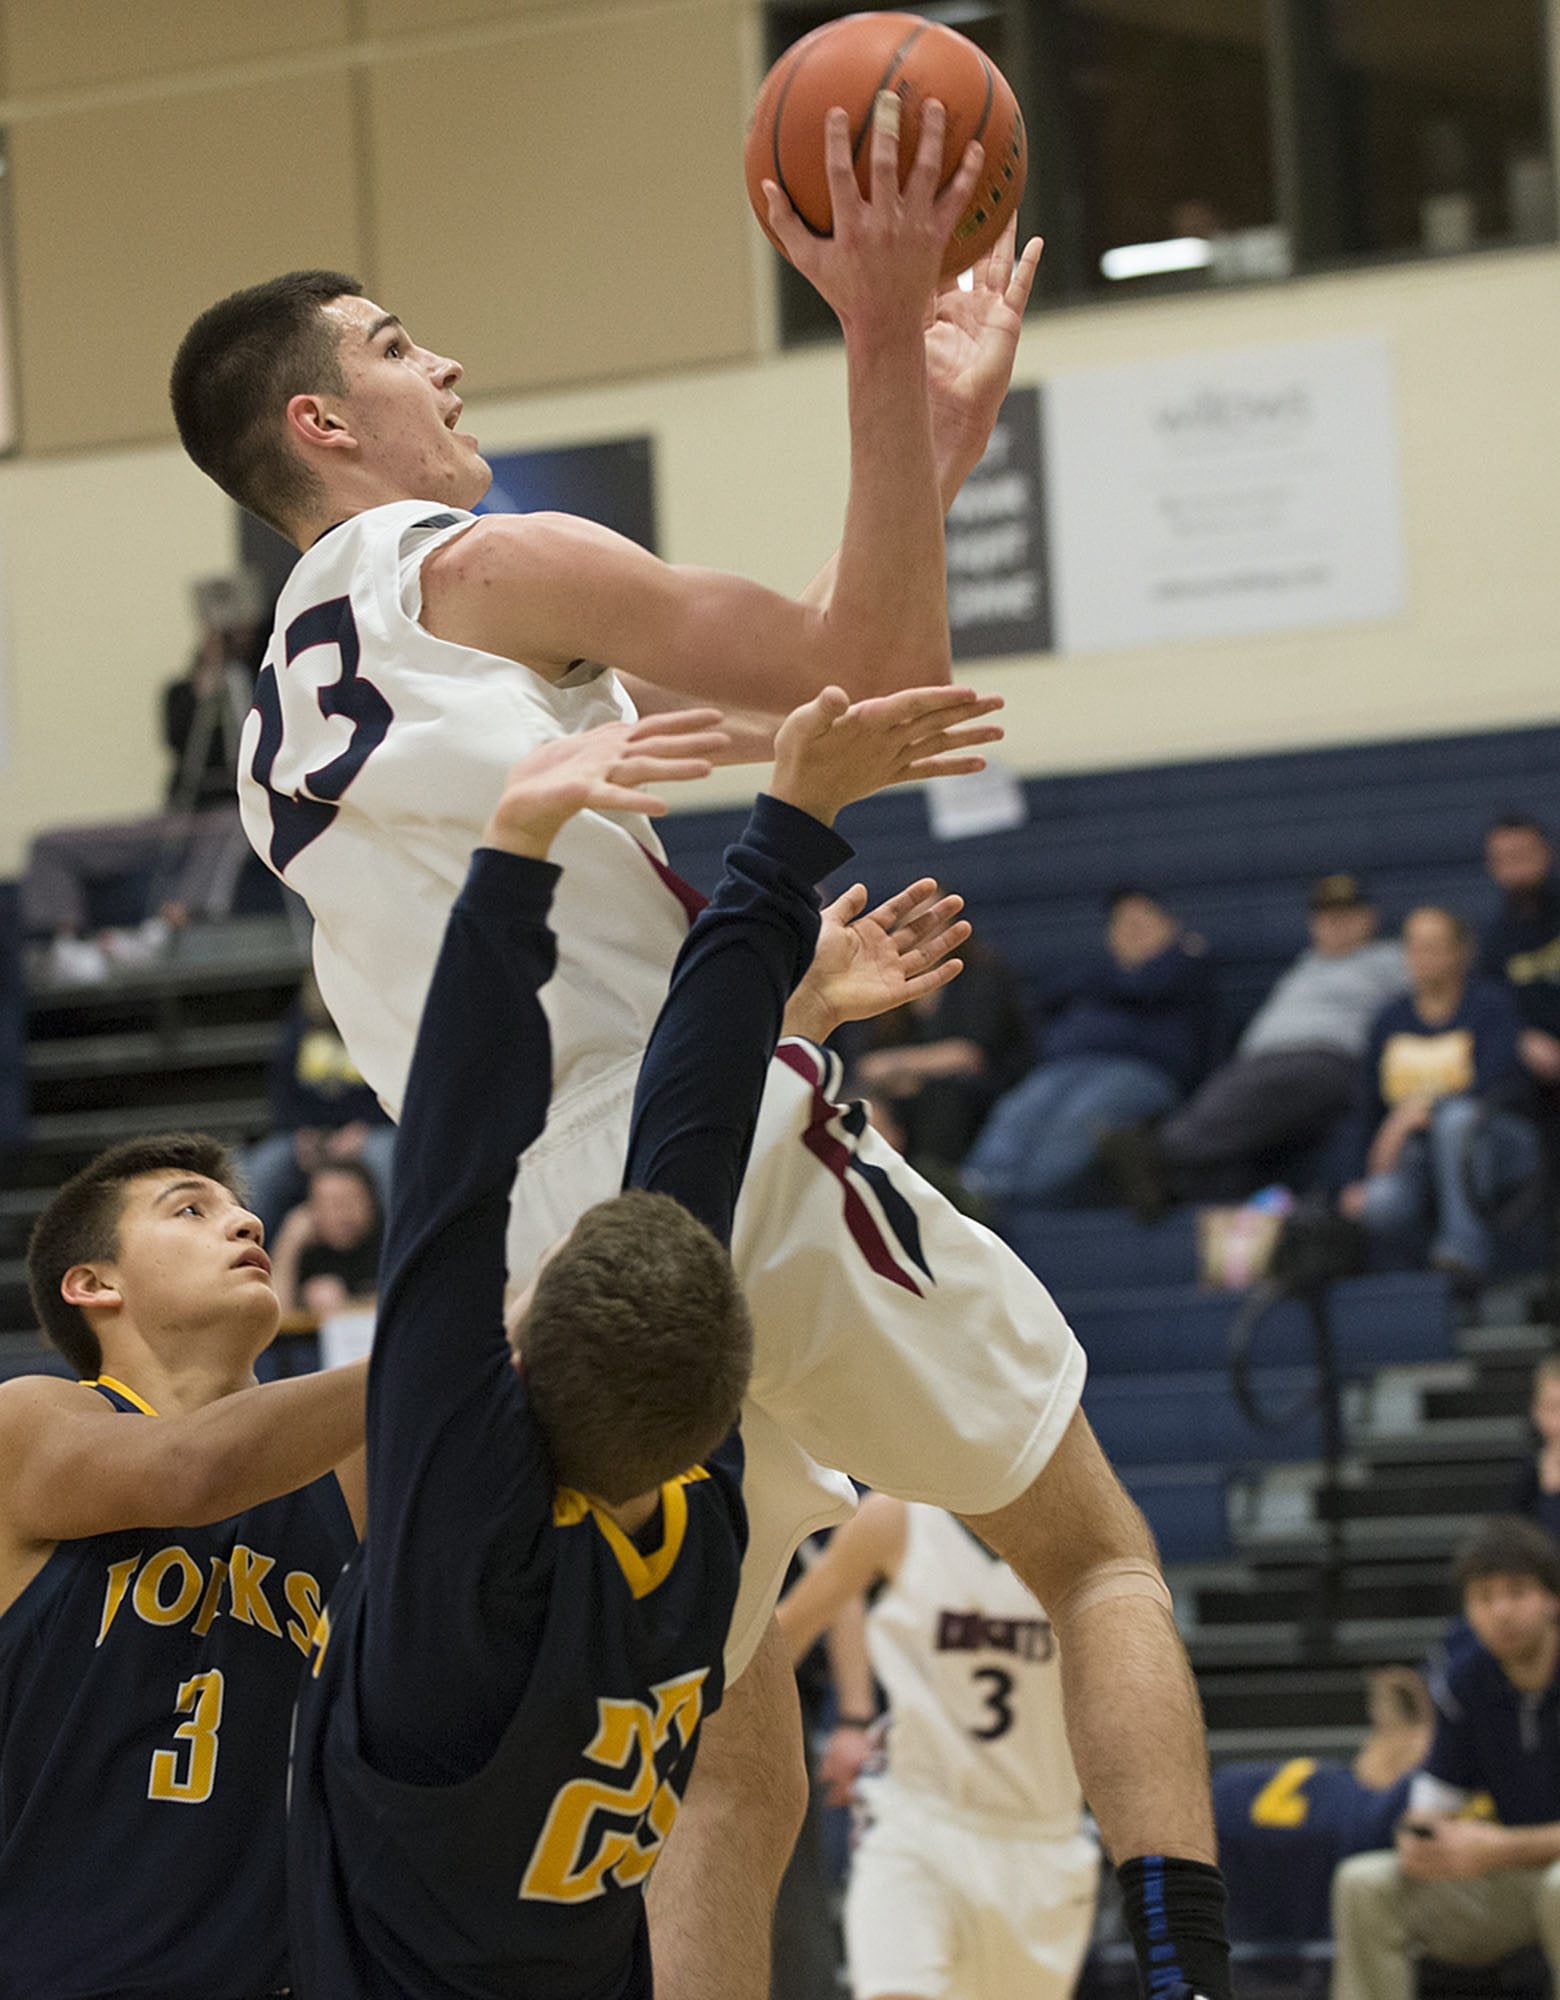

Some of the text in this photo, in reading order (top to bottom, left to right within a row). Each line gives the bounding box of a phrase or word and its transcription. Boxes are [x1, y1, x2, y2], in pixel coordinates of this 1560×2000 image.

[251, 594, 394, 876] 23
[147, 1667, 224, 1804] 3
[967, 1665, 1016, 1743] 3
